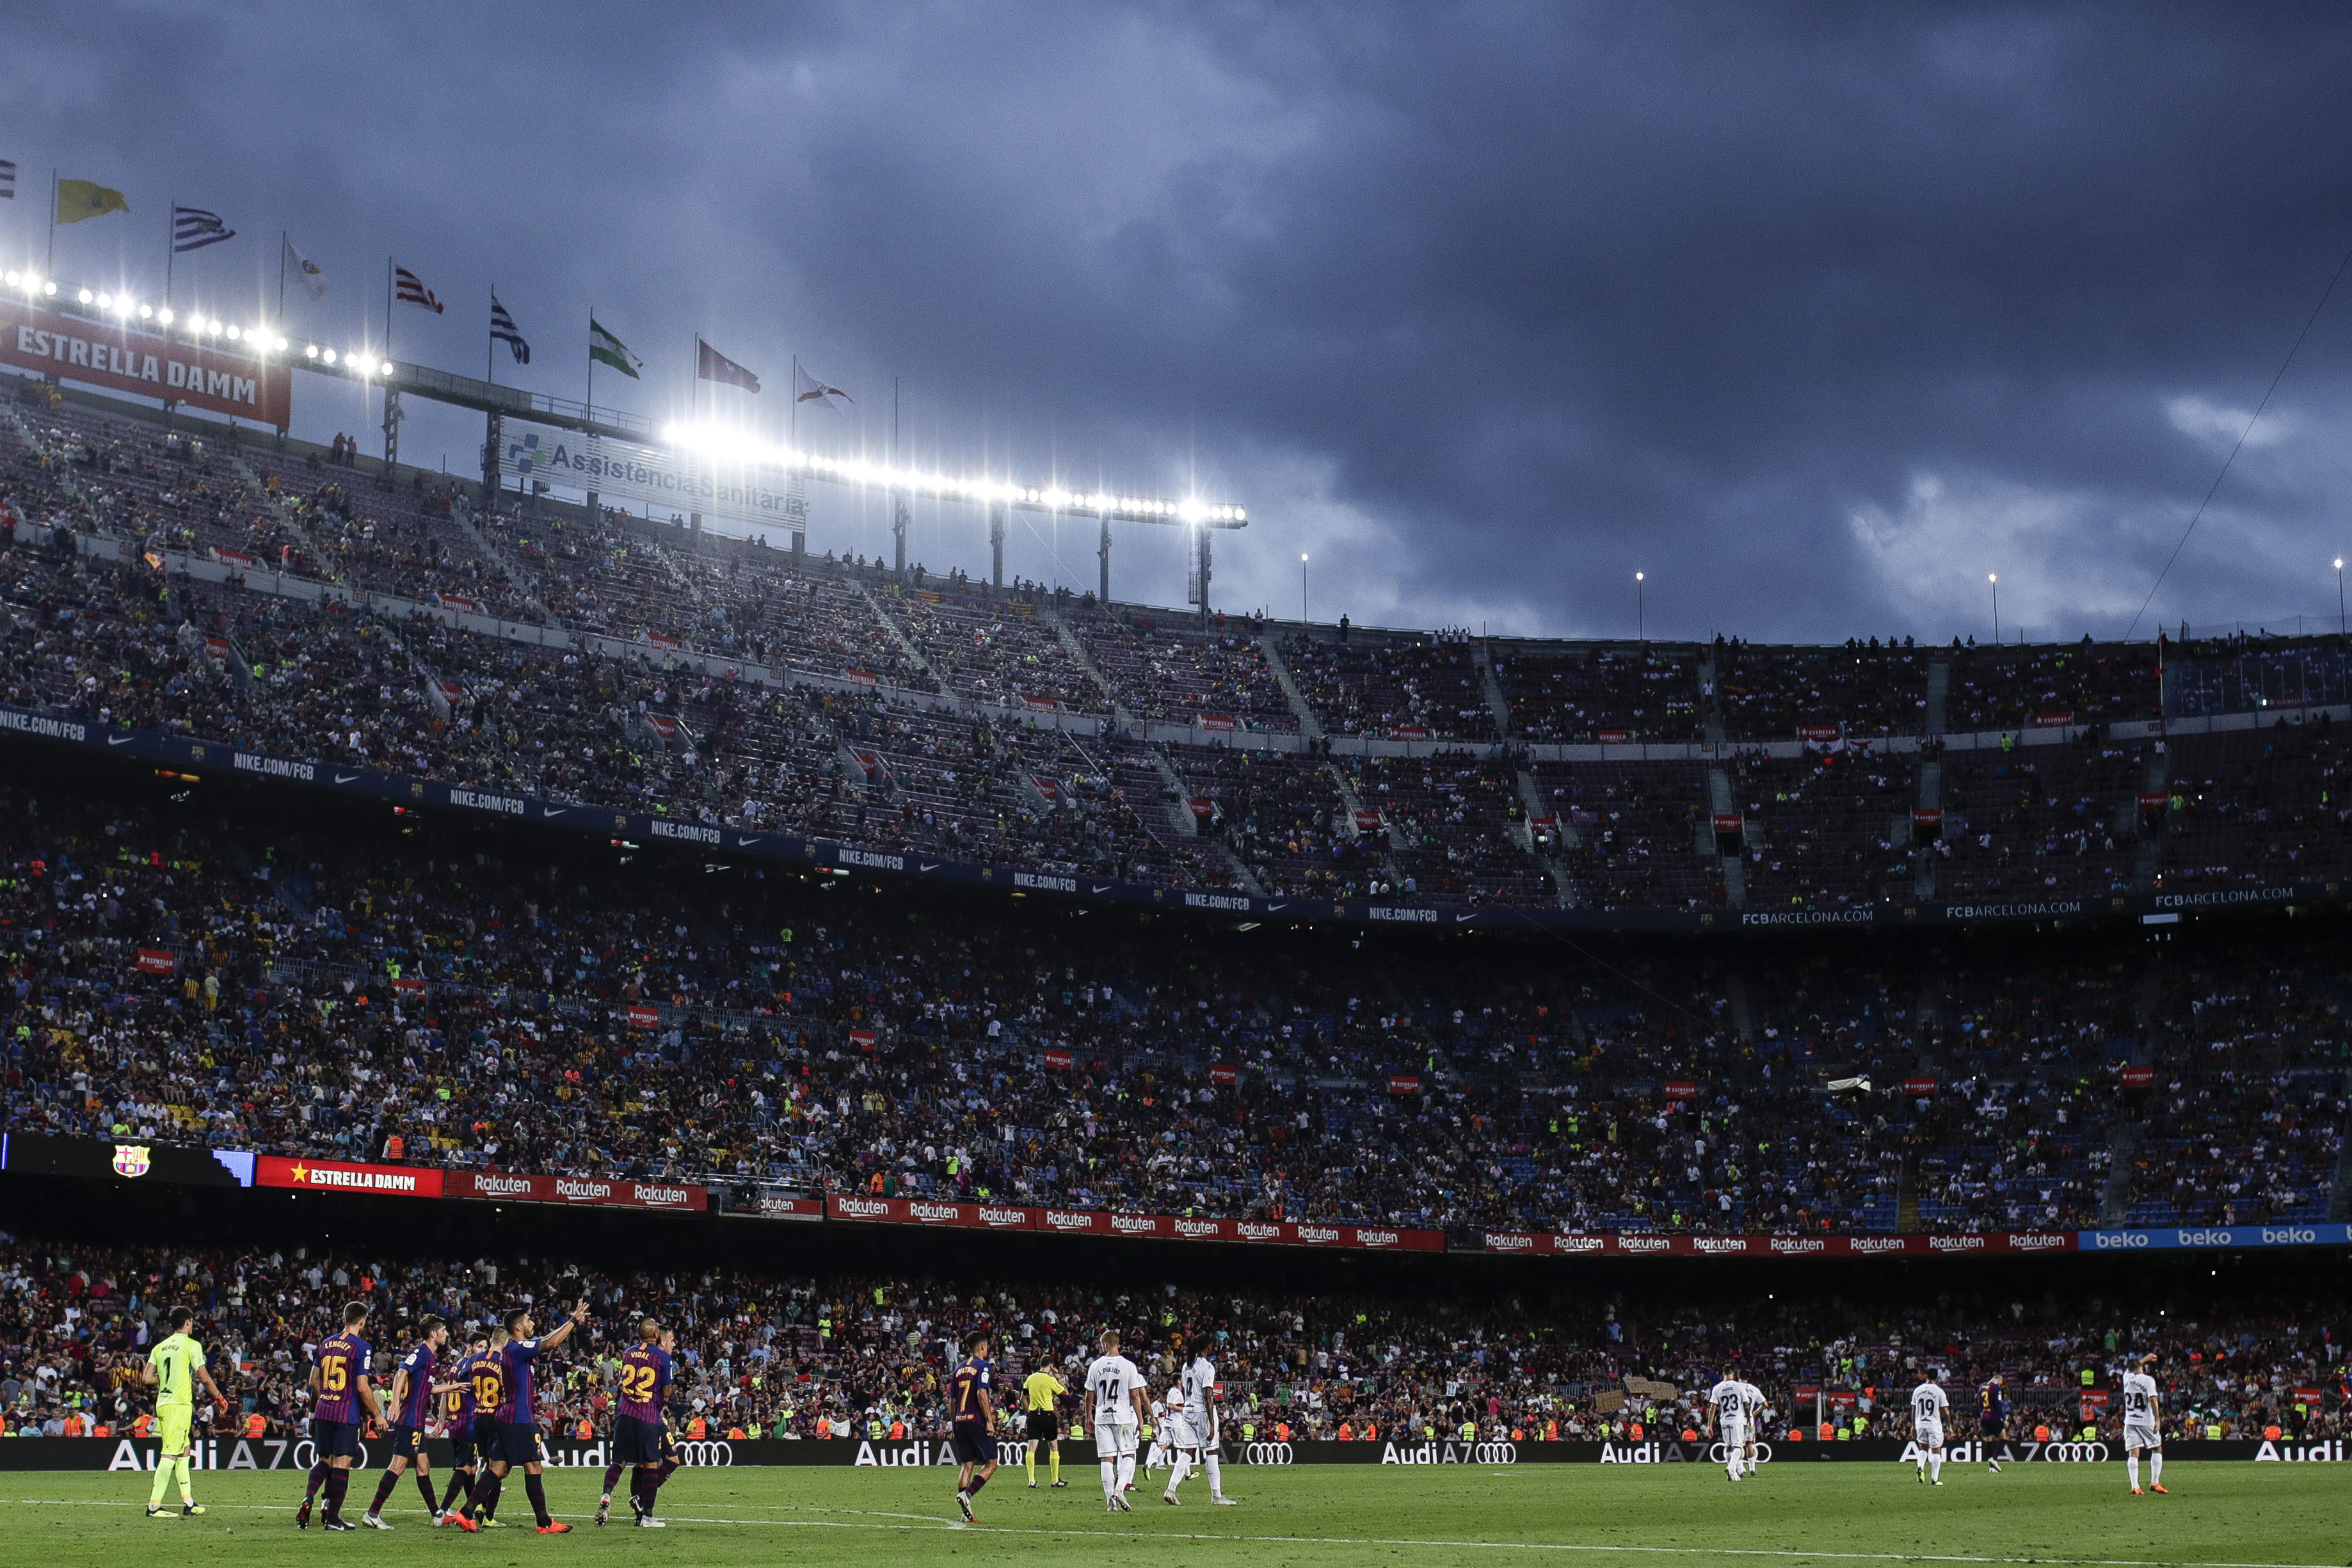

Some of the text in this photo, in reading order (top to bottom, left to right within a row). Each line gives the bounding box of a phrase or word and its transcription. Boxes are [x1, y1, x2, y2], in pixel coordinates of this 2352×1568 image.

[17, 325, 256, 405] ESTRELLA DAMM
[0, 710, 85, 741] NIKE.COM/FCB
[234, 753, 314, 780] NIKE.COM/FCB
[451, 789, 524, 814] NIKE.COM/FCB
[652, 820, 720, 844] NIKE.COM/FCB
[839, 849, 903, 870] NIKE.COM/FCB
[1014, 872, 1076, 892] NIKE.COM/FCB
[1185, 893, 1249, 910] NIKE.COM/FCB
[2156, 887, 2294, 907] FCBARCELONA.COM
[1369, 907, 1437, 922] NIKE.COM/FCB
[1743, 911, 1873, 924] FCBARCELONA.COM
[1947, 901, 2080, 918] FCBARCELONA.COM
[310, 1169, 415, 1190] ESTRELLA DAMM
[475, 1174, 531, 1193] Rakuten
[556, 1180, 610, 1197] Rakuten
[634, 1185, 687, 1203] Rakuten
[760, 1198, 793, 1210] akuten
[839, 1197, 888, 1214] Rakuten
[910, 1203, 957, 1219] Rakuten
[979, 1207, 1025, 1224] Rakuten
[1046, 1211, 1092, 1227] Rakuten
[1112, 1215, 1155, 1231] Rakuten
[1175, 1219, 1218, 1235] Rakuten
[1238, 1222, 1279, 1237] Rakuten
[1298, 1226, 1338, 1240] Rakuten
[1357, 1229, 1397, 1244] Rakuten
[1486, 1234, 1532, 1247] Rakuten
[1554, 1235, 1603, 1249] Rakuten
[1619, 1236, 1670, 1249] Rakuten
[1693, 1238, 1746, 1250] Rakuten
[1771, 1238, 1824, 1250] Rakuten
[1850, 1237, 1905, 1250] Rakuten
[1930, 1235, 1984, 1248] Rakuten
[2010, 1234, 2065, 1247] Rakuten
[2096, 1232, 2148, 1248] beko
[2179, 1229, 2232, 1245] beko
[2262, 1228, 2316, 1244] beko
[630, 1351, 650, 1360] VIDAL
[163, 1356, 171, 1385] 1
[321, 1355, 348, 1391] 15
[621, 1364, 656, 1399] 22
[472, 1375, 499, 1408] 18
[959, 1380, 971, 1412] 7
[1099, 1379, 1120, 1407] 14
[1981, 1391, 1988, 1407] 3
[1722, 1394, 1738, 1412] 23
[1919, 1398, 1934, 1416] 19
[2125, 1392, 2147, 1412] 24
[534, 1433, 541, 1444] 9
[666, 1432, 675, 1446] 8
[228, 1439, 287, 1470] A7
[854, 1441, 958, 1466] Audi A
[1382, 1442, 1472, 1464] Audi A7
[1600, 1442, 1709, 1463] Audi A7
[2255, 1439, 2342, 1462] Audi
